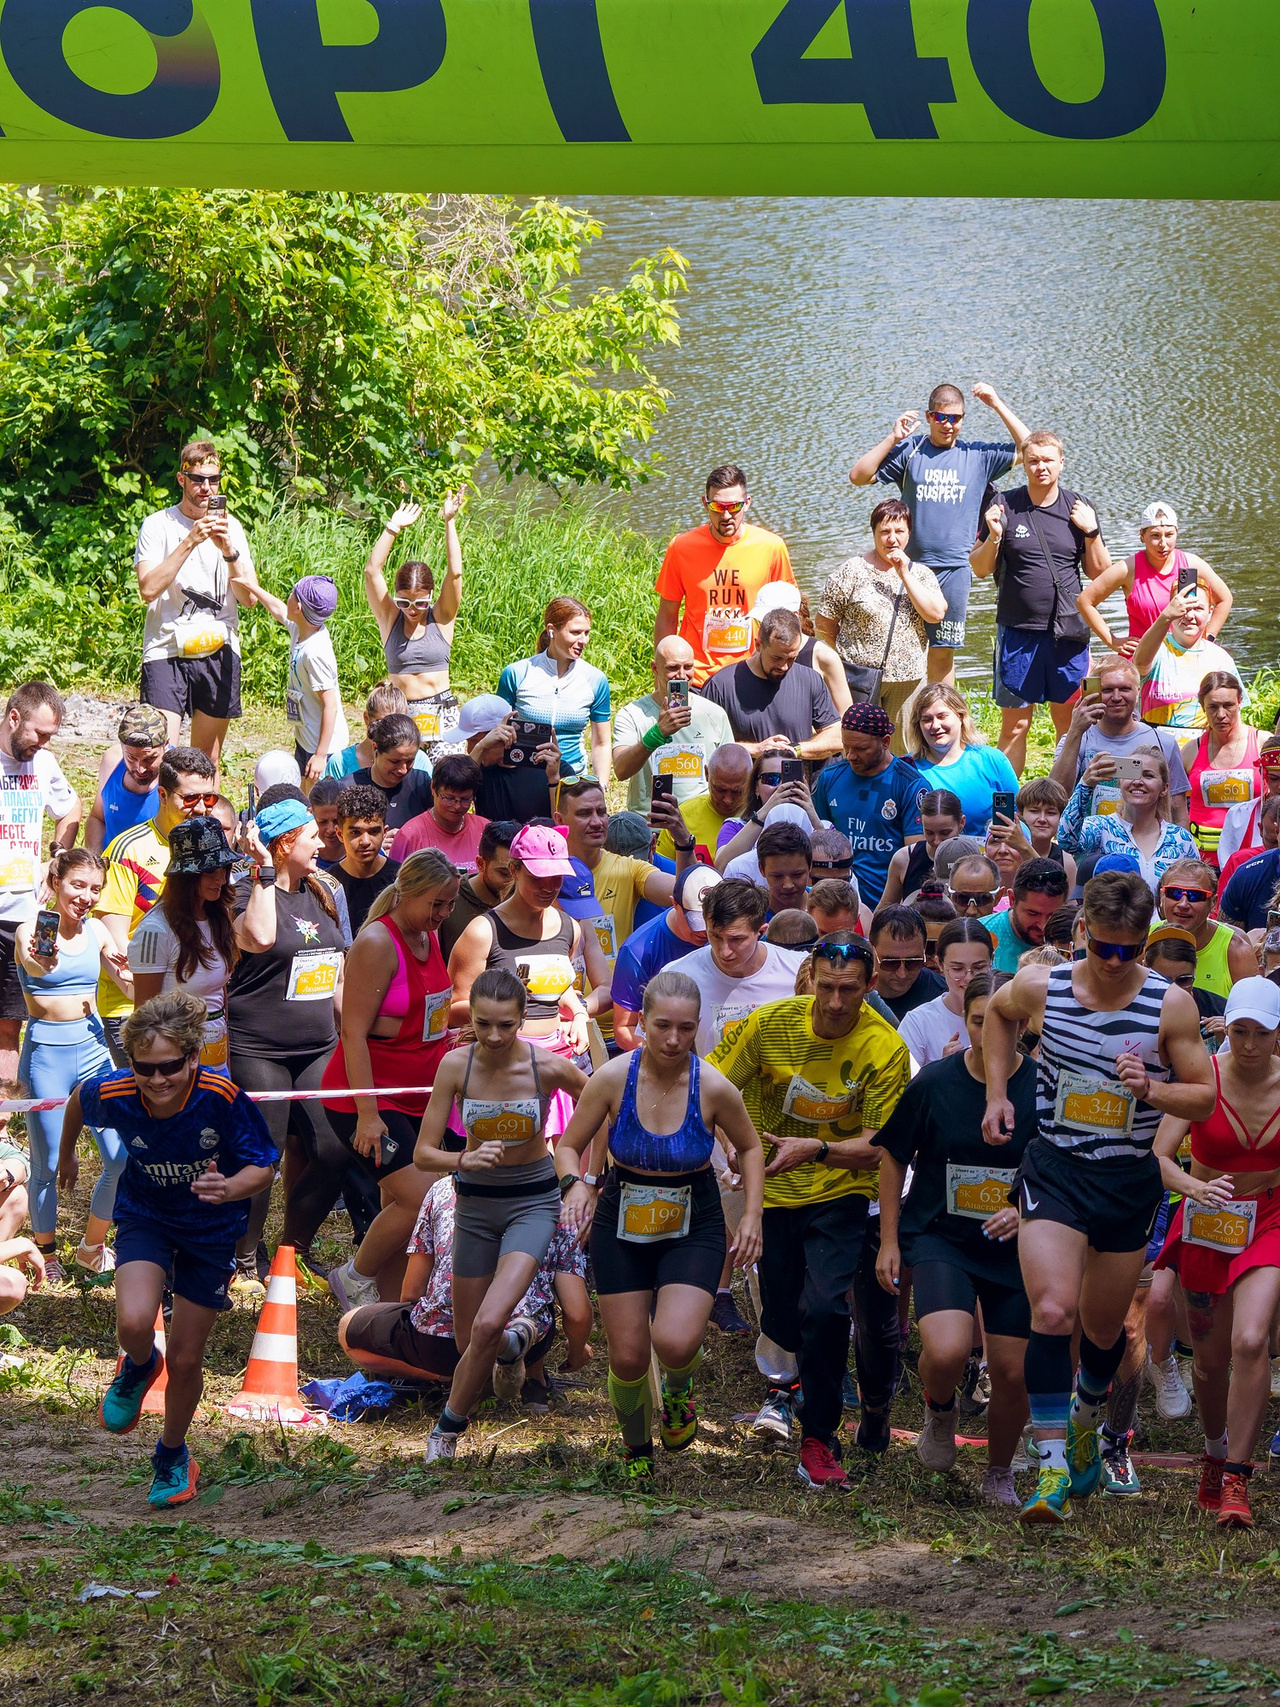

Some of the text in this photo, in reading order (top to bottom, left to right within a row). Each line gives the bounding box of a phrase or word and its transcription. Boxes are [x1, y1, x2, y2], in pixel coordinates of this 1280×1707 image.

[750, 0, 1167, 140] 40
[924, 468, 962, 485] USUAL
[916, 485, 968, 505] SUSPECT
[714, 569, 740, 587] WE
[709, 589, 746, 606] RUN
[199, 633, 222, 647] 415
[724, 630, 746, 642] 440
[415, 714, 435, 730] 579
[675, 757, 699, 770] 560
[1223, 784, 1246, 796] 561
[11, 808, 38, 823] БЕГУТ
[848, 817, 866, 833] Fly
[848, 831, 894, 852] irates
[313, 970, 335, 986] 515
[543, 970, 567, 986] 733
[713, 1018, 750, 1064] SPORT
[816, 1102, 851, 1116] 617
[1088, 1097, 1123, 1117] 344
[496, 1119, 529, 1133] 691
[1070, 1111, 1120, 1127] Александр
[490, 1132, 518, 1141] Дарья
[959, 1186, 1011, 1204] 5K 635
[964, 1201, 1011, 1212] Анастаси
[628, 1207, 681, 1225] 5K 199
[641, 1225, 665, 1234] Анна
[1213, 1217, 1245, 1238] 265
[1201, 1229, 1239, 1244] Светлана
